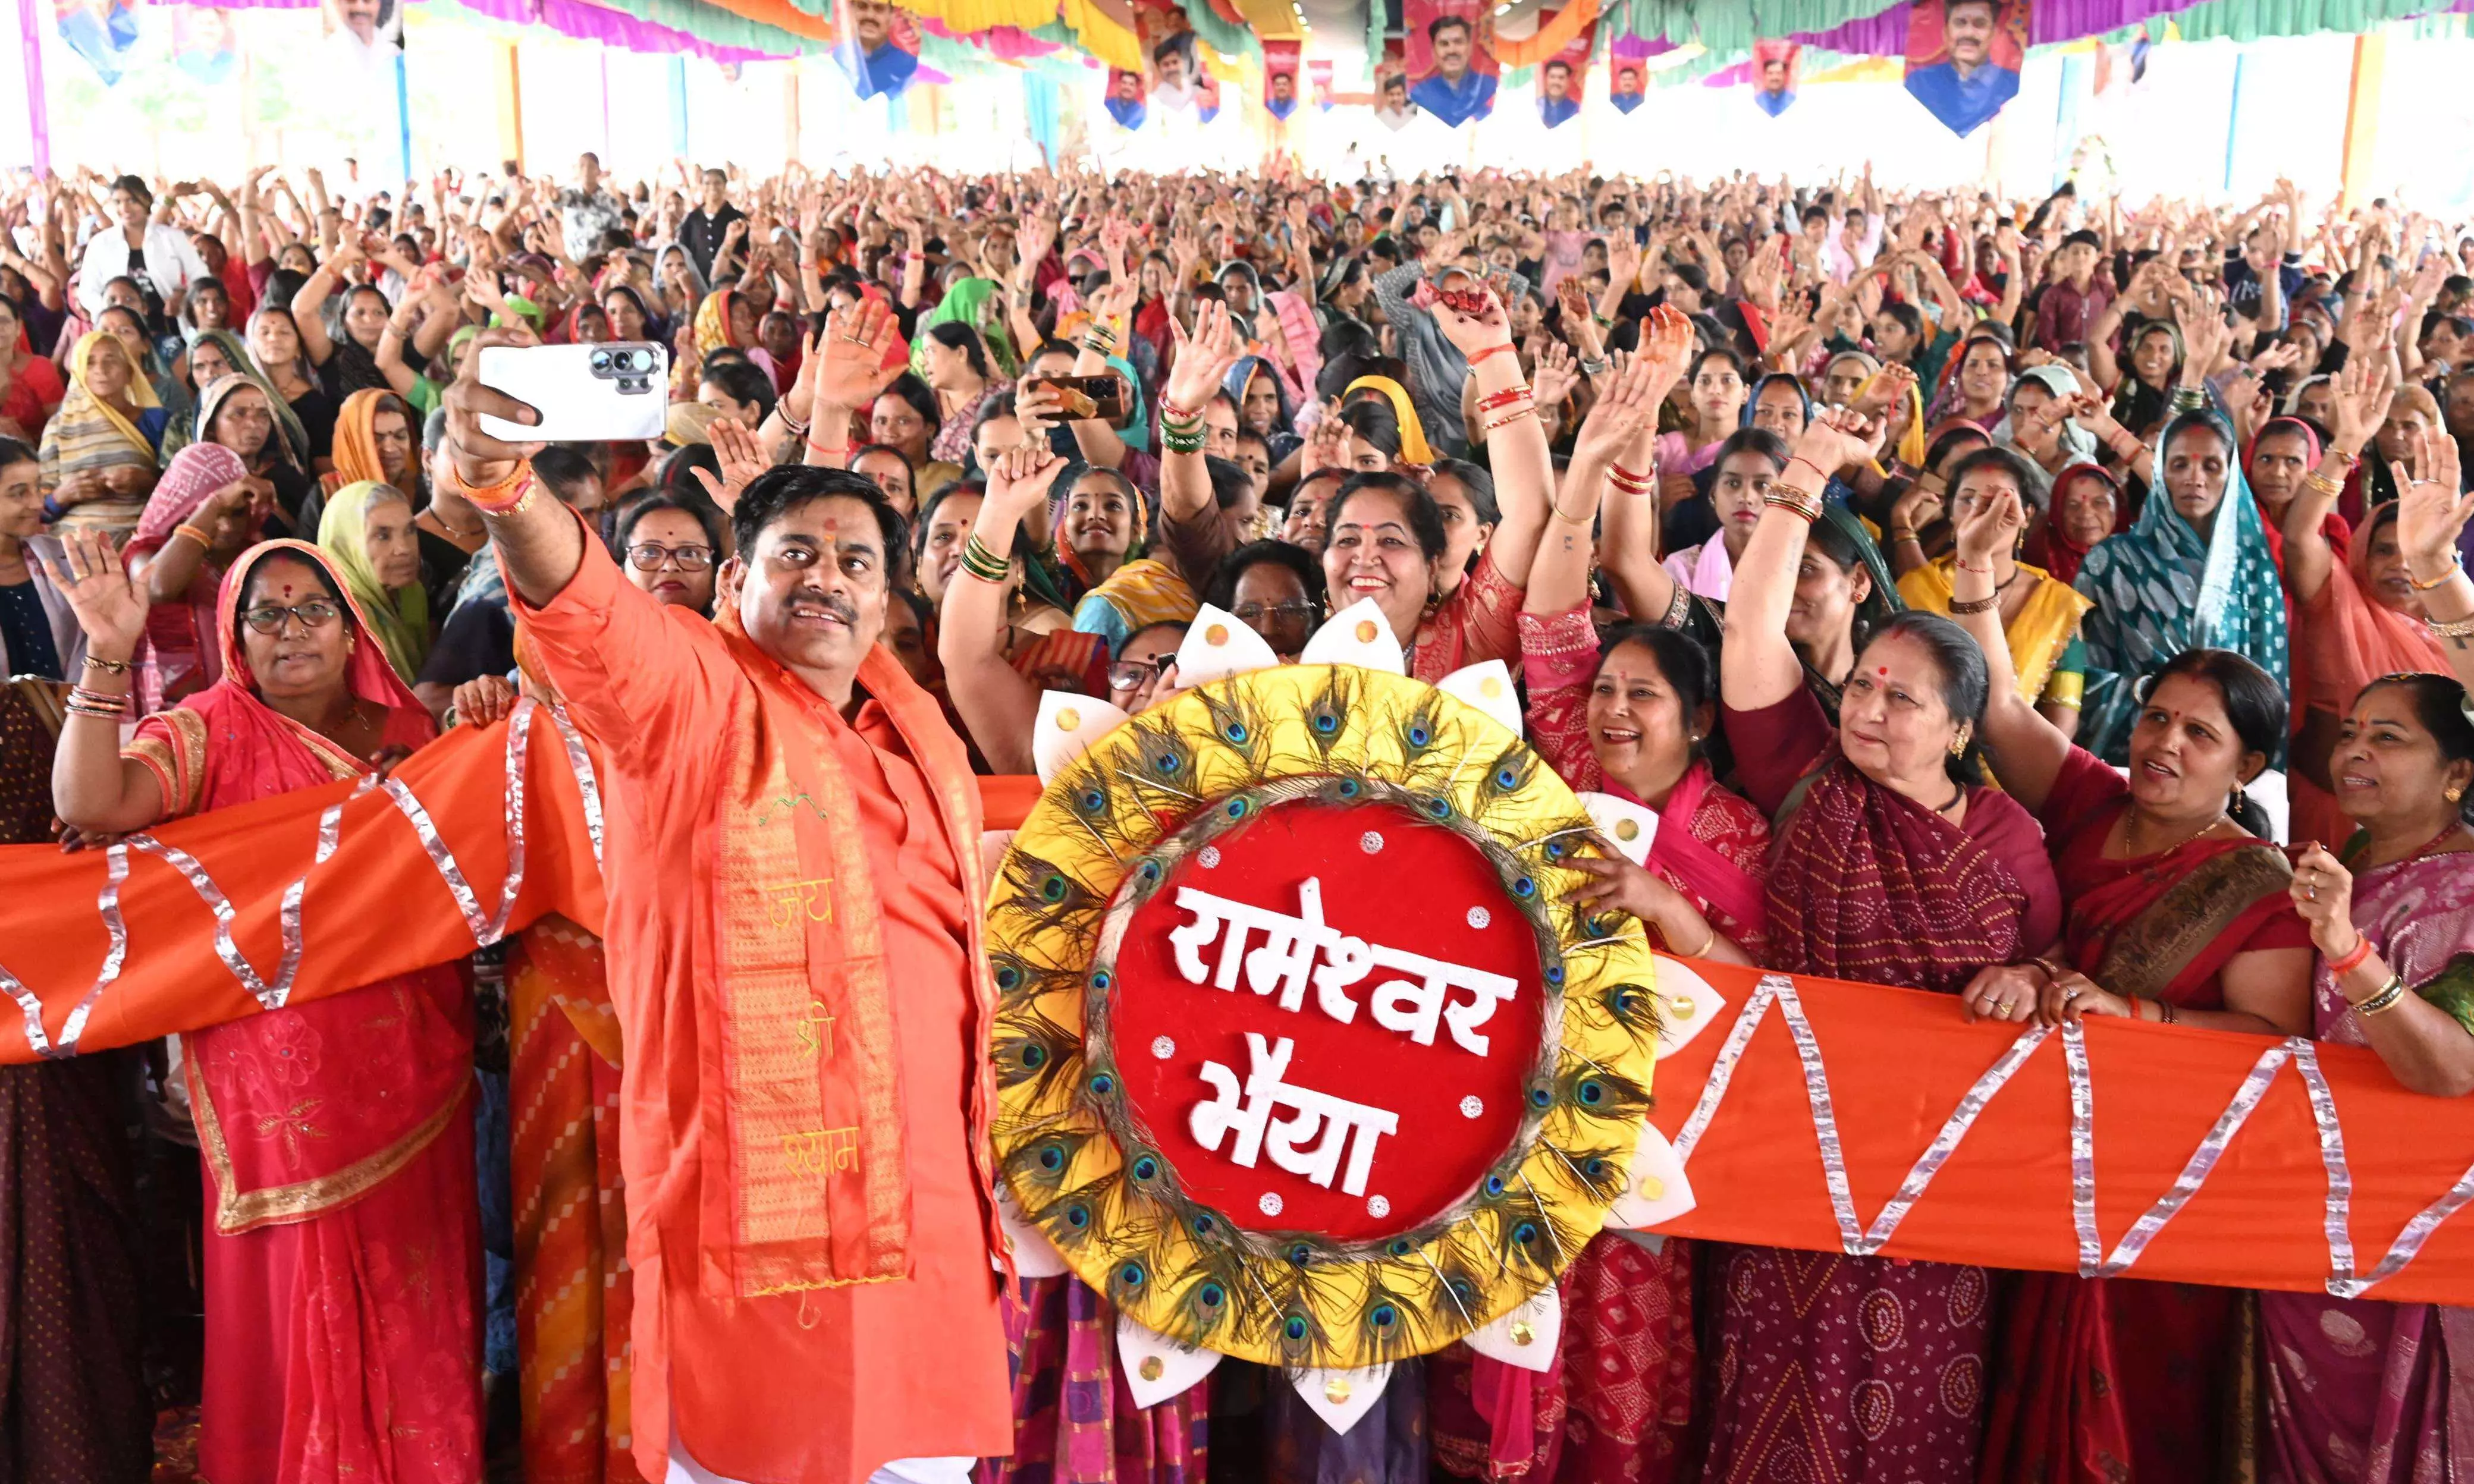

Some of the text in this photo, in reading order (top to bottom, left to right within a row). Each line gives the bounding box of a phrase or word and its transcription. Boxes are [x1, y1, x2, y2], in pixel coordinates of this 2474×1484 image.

[766, 878, 834, 930] जय
[1169, 876, 1518, 1057] रामेश्वर
[796, 1001, 835, 1060] श्री
[1190, 1032, 1399, 1197] भैया
[779, 1126, 860, 1180] श्याम
